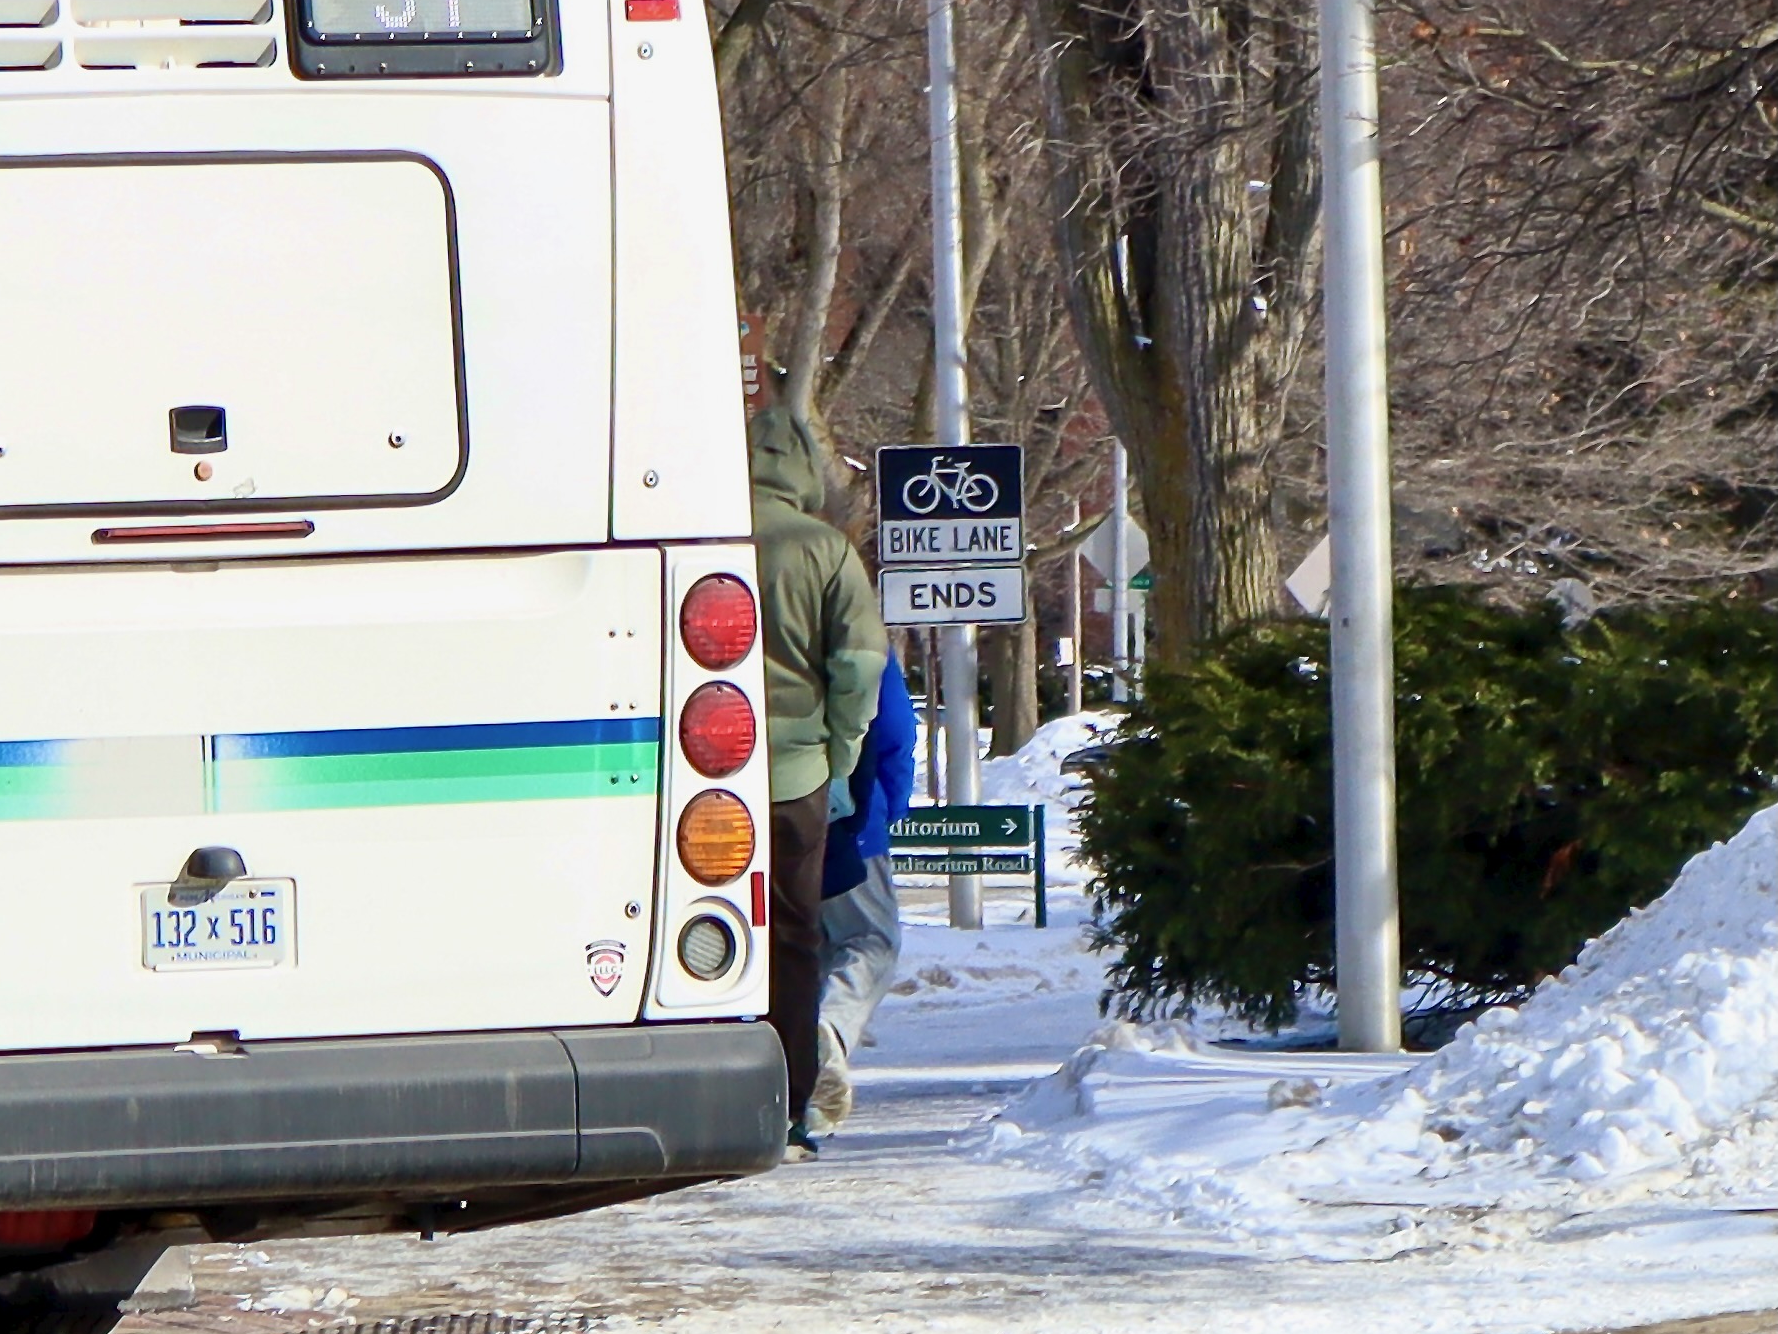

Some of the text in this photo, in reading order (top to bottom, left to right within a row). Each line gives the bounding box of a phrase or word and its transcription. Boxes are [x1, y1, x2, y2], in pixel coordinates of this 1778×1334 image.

[890, 525, 1013, 554] BIKE LANE
[910, 581, 997, 610] ENDS
[889, 818, 981, 837] ditorium
[892, 856, 1026, 873] uditorium Road
[152, 910, 197, 948] 132
[230, 908, 276, 945] 516
[176, 949, 253, 962] MUNICIPAL
